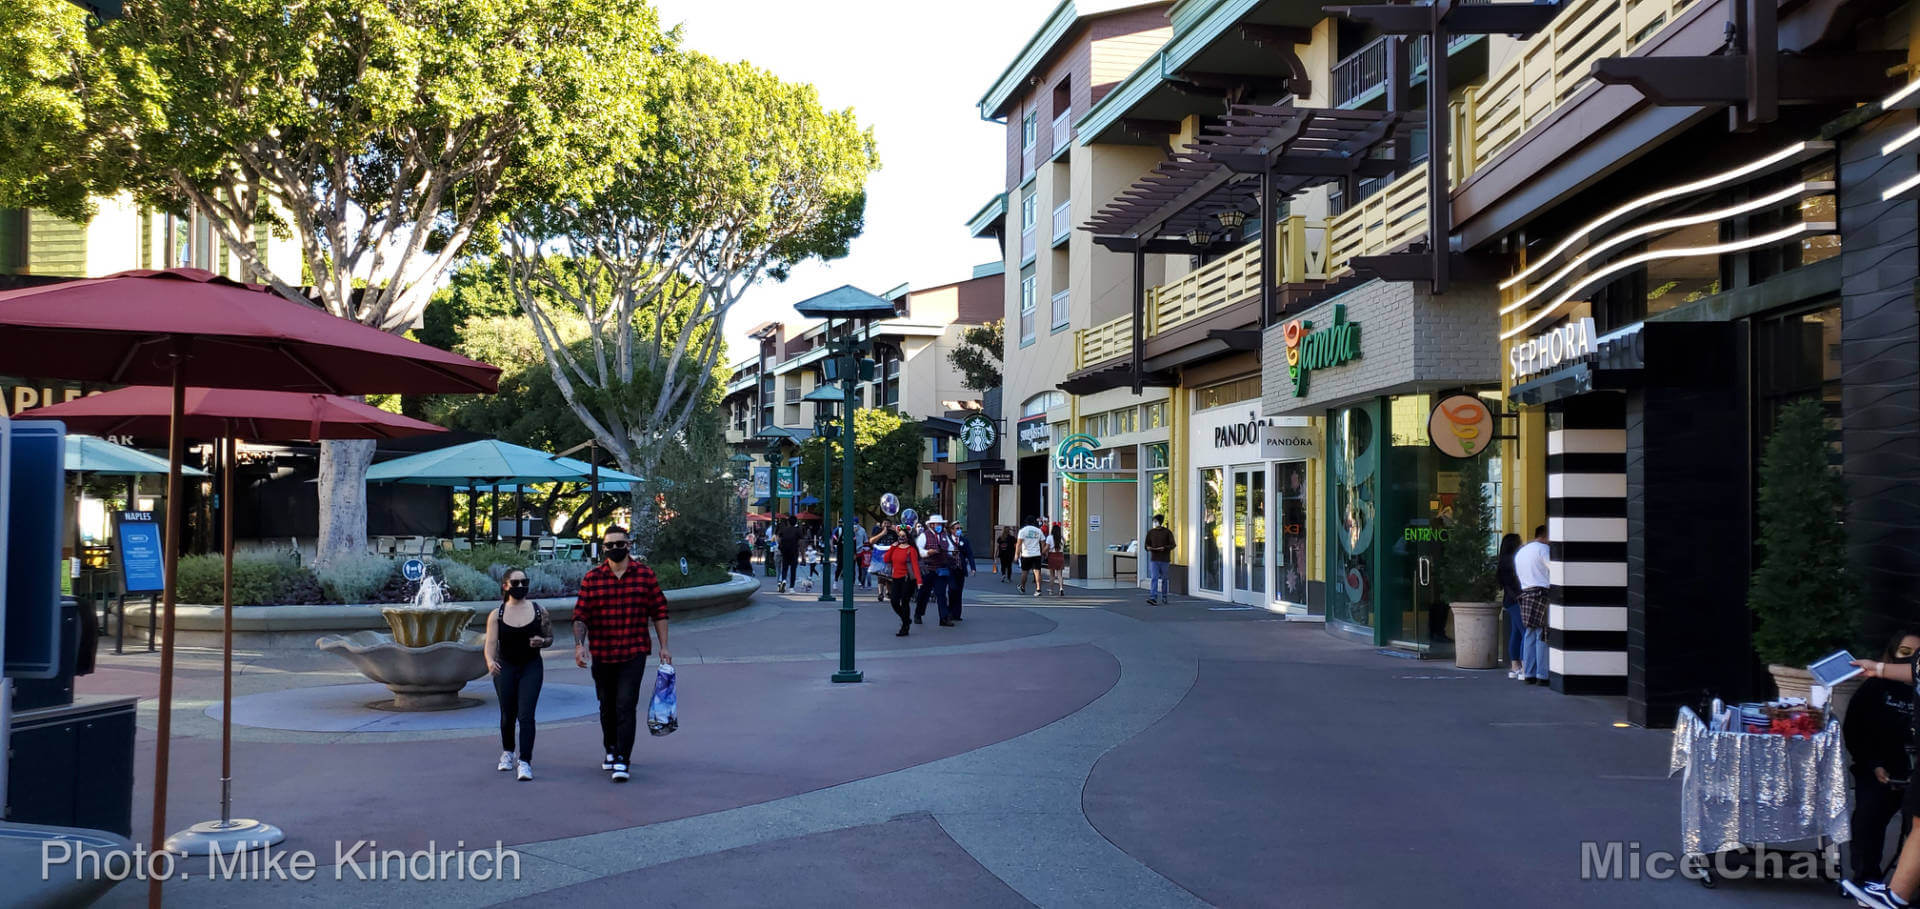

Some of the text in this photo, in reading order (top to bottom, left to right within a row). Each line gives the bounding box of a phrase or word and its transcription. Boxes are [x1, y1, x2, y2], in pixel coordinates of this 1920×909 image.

[1510, 317, 1595, 380] SEPHORA
[1214, 411, 1274, 449] PANDO
[124, 512, 152, 521] NAPLES
